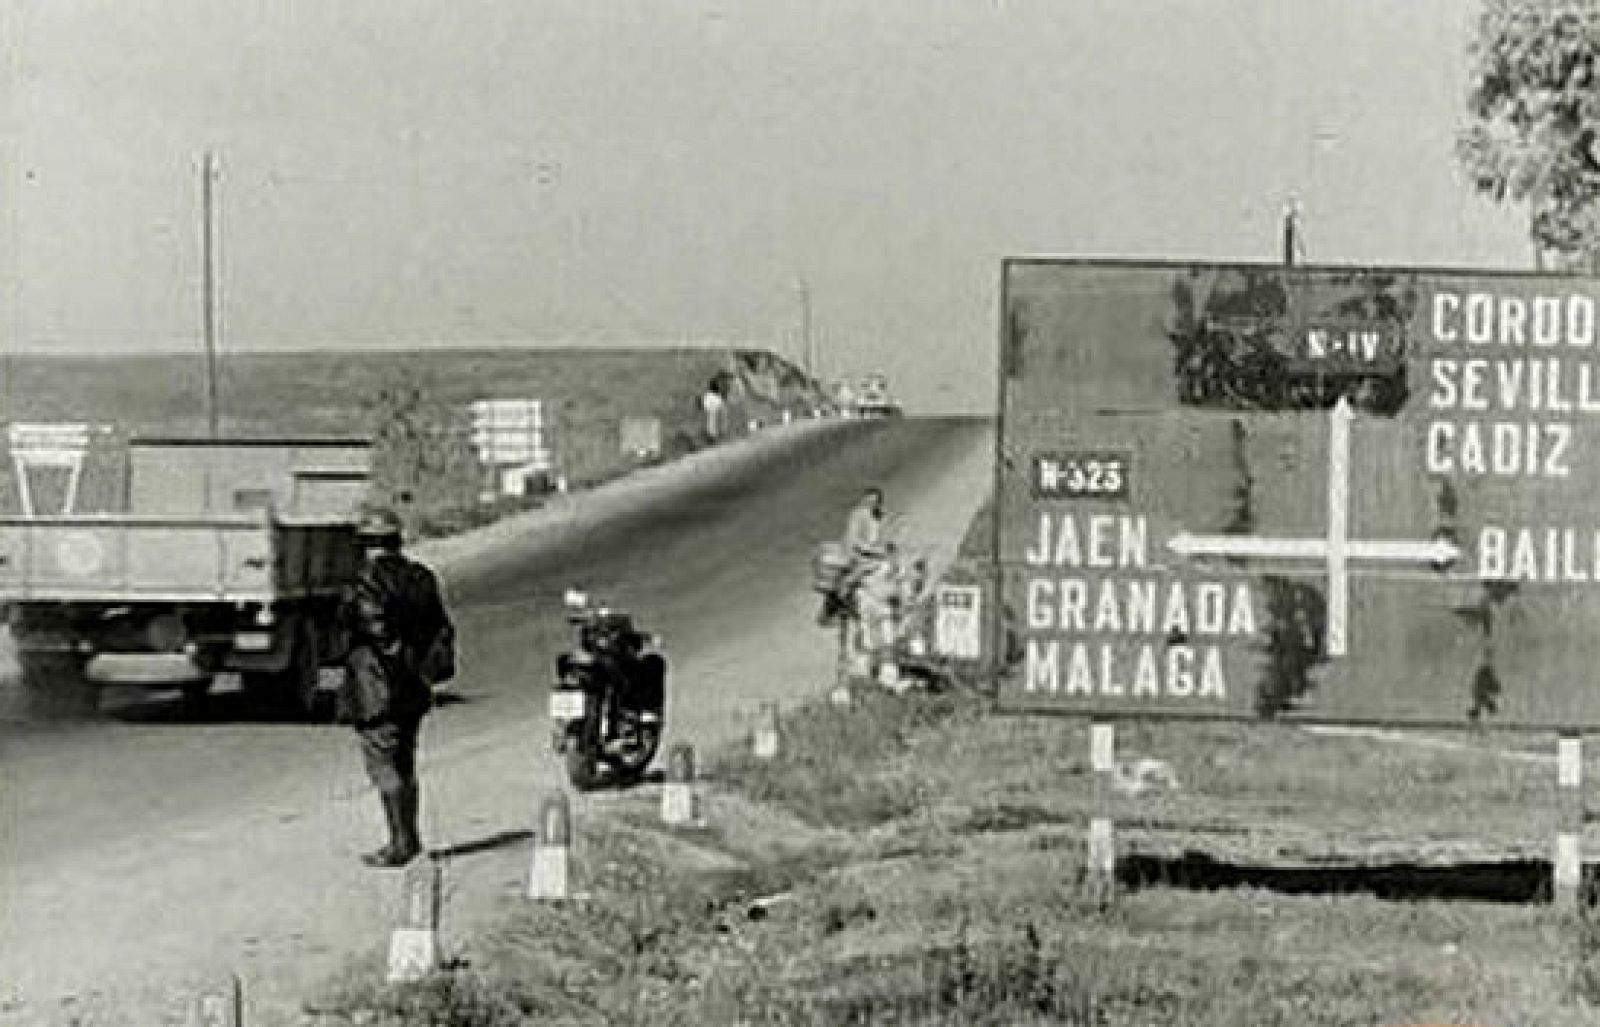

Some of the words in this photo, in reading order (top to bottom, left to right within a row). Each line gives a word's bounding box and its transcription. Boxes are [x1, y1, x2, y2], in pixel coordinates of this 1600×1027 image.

[1428, 422, 1571, 476] CADIZ
[1027, 513, 1146, 567] JAEN
[1480, 527, 1600, 581] BAIL
[1029, 578, 1254, 634] GRANADA
[1026, 641, 1224, 697] MALAGA
